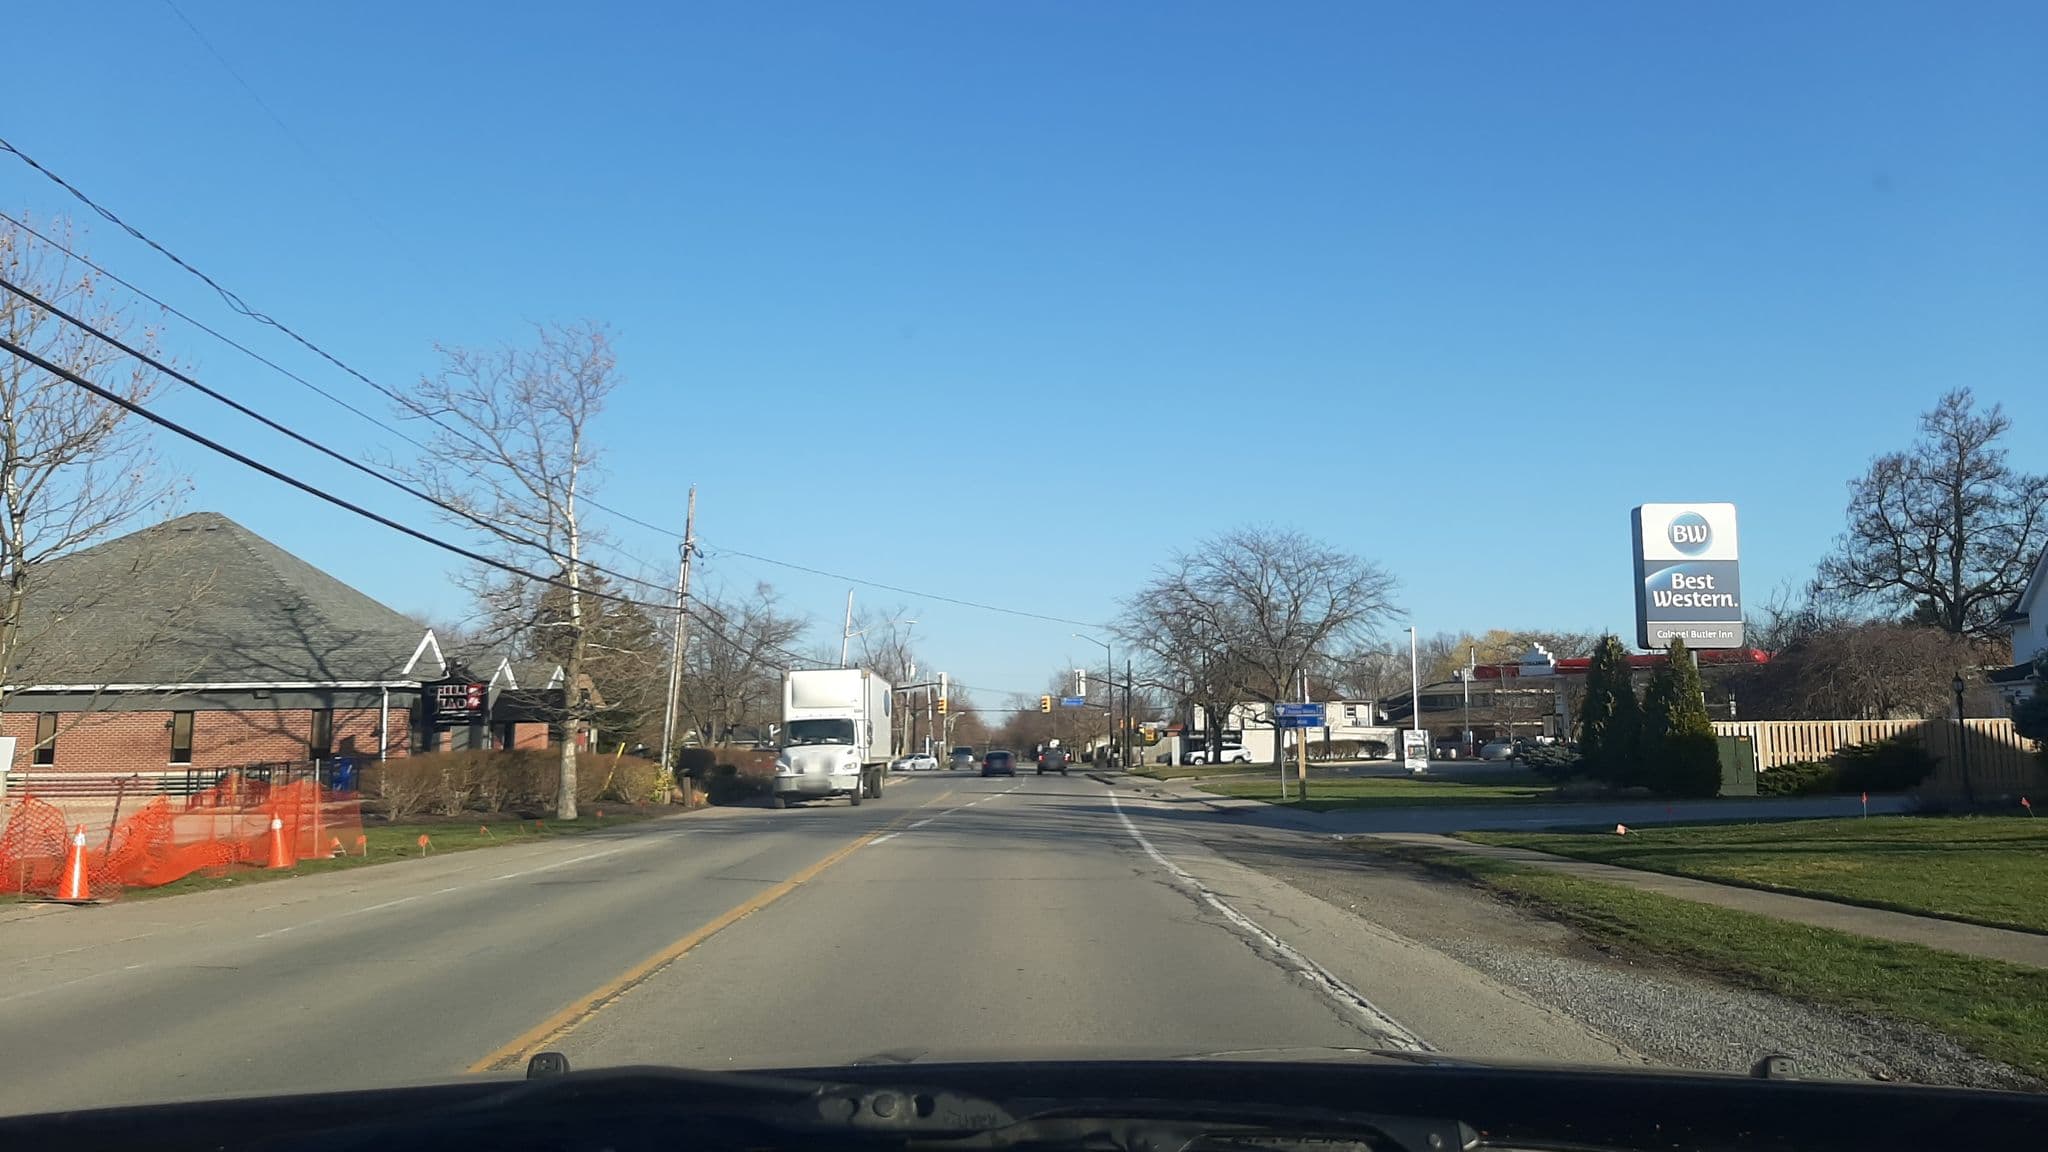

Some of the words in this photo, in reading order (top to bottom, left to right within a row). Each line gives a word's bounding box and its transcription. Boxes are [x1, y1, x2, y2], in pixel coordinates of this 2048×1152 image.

[1673, 525, 1707, 543] BW
[1671, 573, 1715, 589] Best
[1691, 630, 1717, 639] Butler
[1719, 630, 1733, 639] Inn
